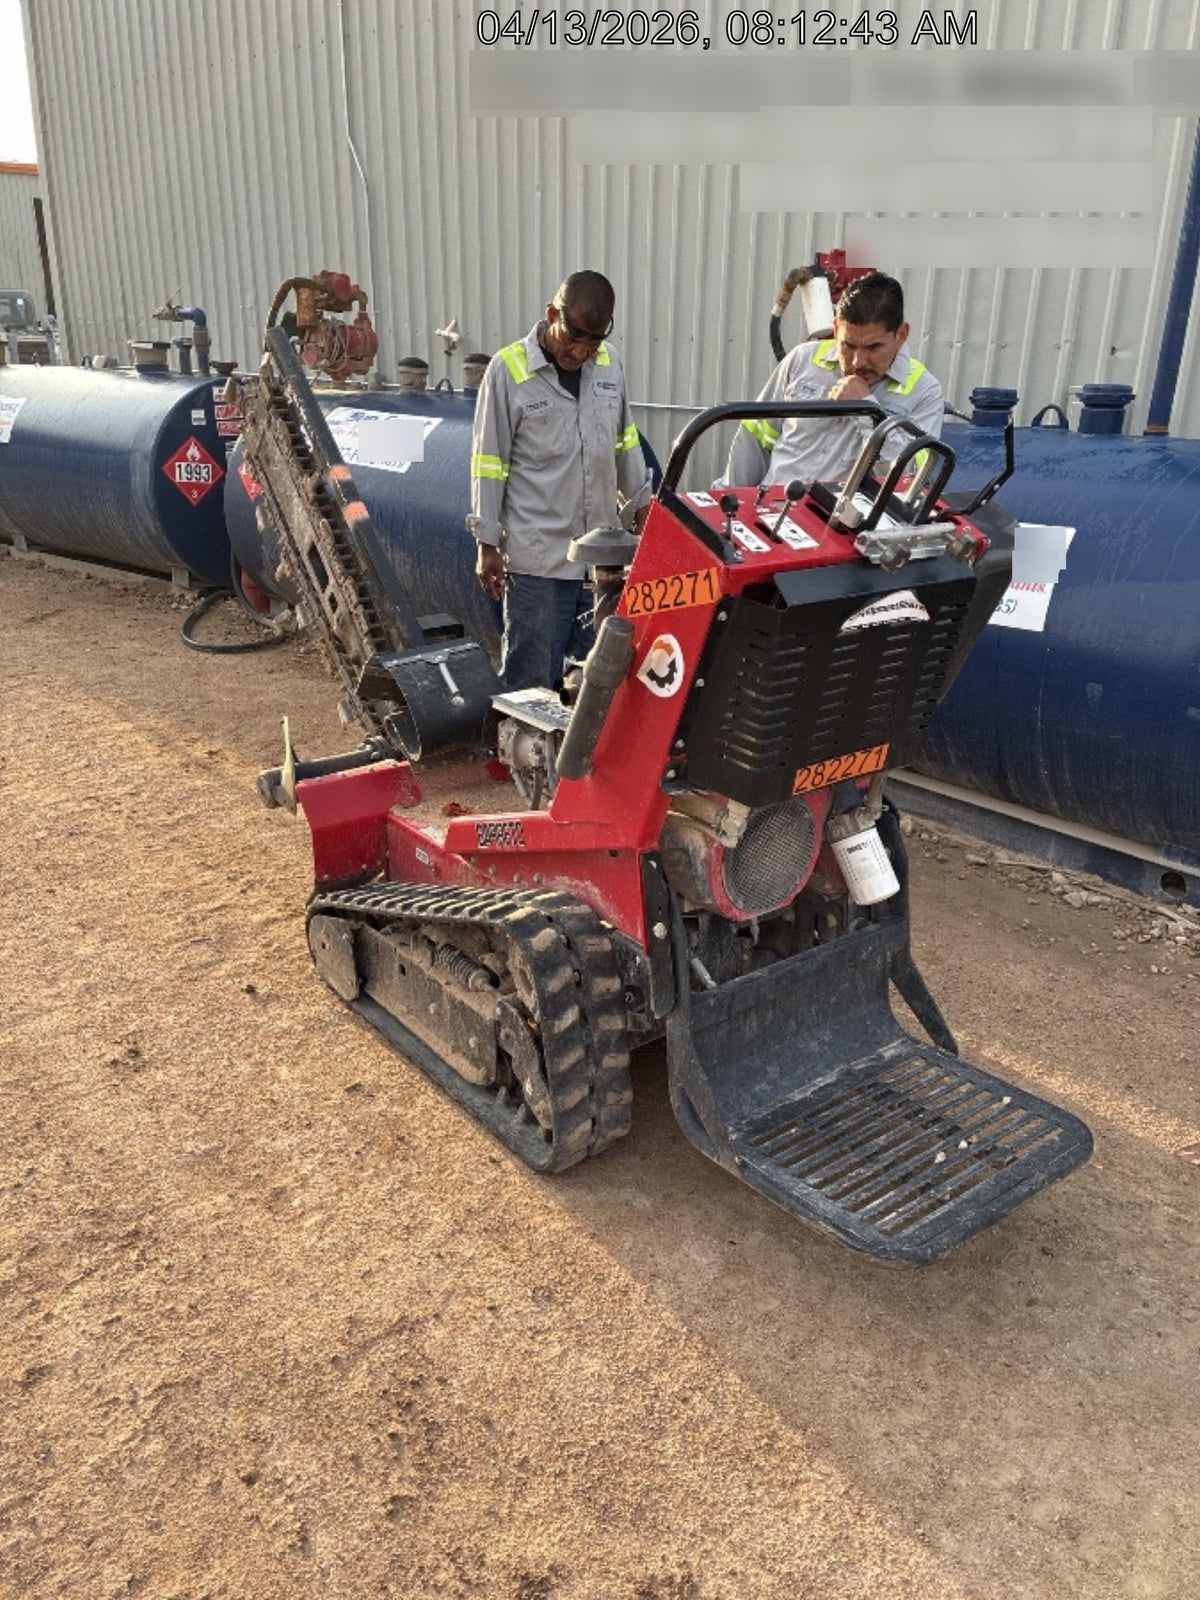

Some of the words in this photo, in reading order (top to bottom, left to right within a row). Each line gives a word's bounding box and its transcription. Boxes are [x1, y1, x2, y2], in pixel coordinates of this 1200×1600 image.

[176, 463, 211, 482] 1993
[191, 488, 198, 499] 3
[626, 568, 714, 615] 282271
[794, 746, 884, 794] 282271
